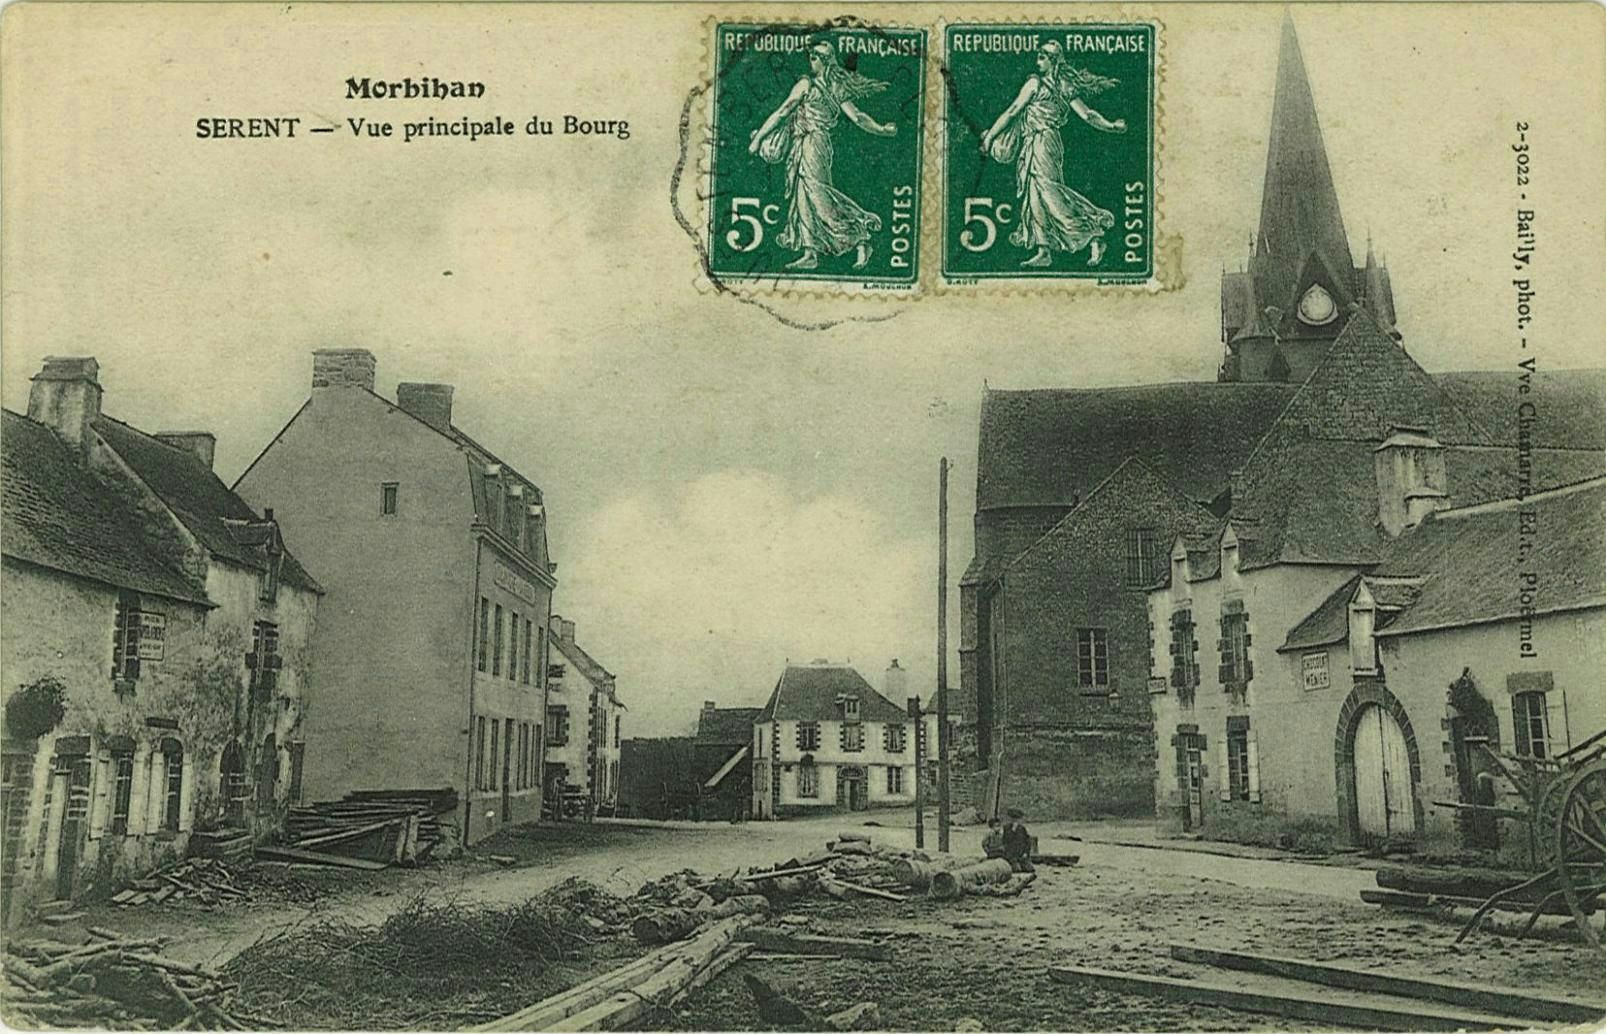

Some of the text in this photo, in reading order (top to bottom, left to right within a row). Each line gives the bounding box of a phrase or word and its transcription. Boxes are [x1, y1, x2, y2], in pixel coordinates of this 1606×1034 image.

[1066, 34, 1145, 55] FRANÇAISE
[891, 185, 912, 268] POSTES
[1124, 181, 1144, 263] POSTES
